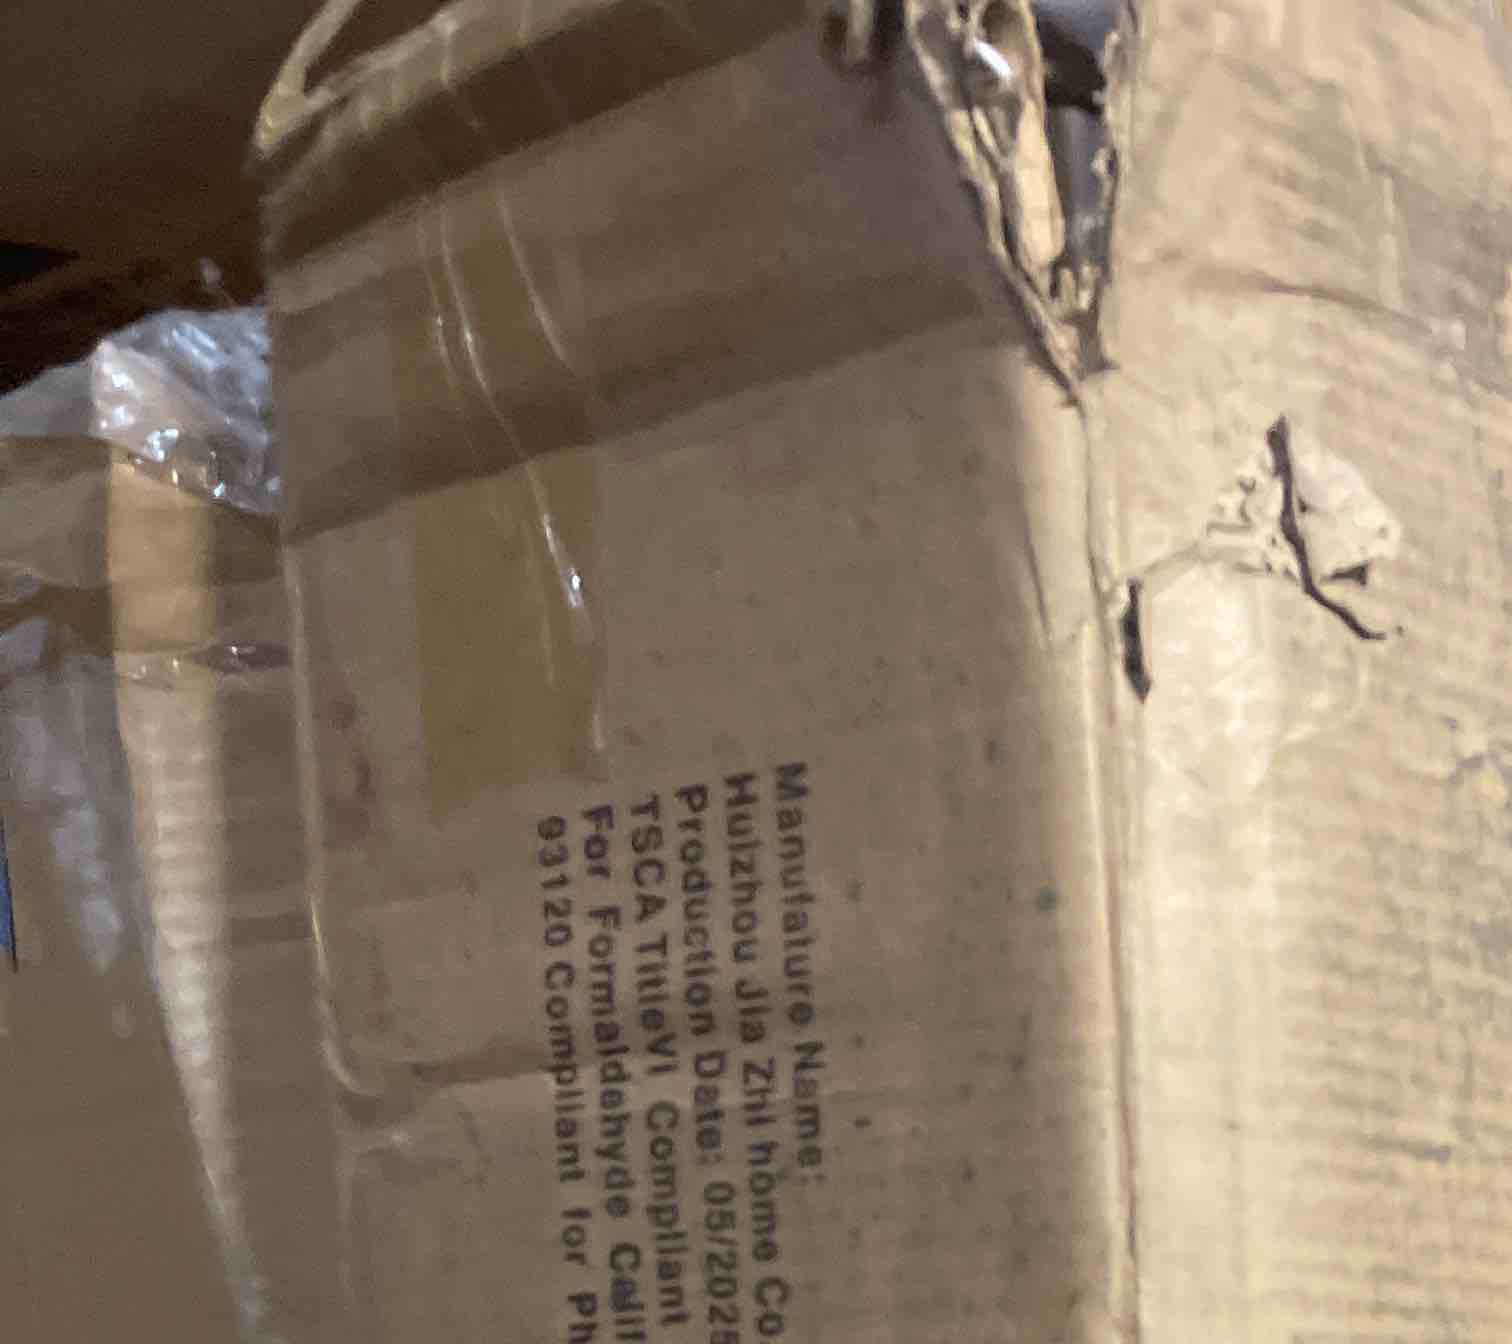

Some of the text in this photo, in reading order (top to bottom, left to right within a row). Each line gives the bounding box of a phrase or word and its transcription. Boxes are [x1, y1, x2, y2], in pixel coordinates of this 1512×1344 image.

[537, 815, 576, 947] 93120
[581, 805, 615, 879] For
[629, 793, 670, 923] TSCA
[723, 774, 772, 964] Huizhou
[675, 784, 718, 1037] Production
[541, 960, 586, 1183] Compliant
[585, 906, 639, 1217] Formaldehyde
[733, 977, 772, 1043] Jia
[690, 1051, 726, 1167] Date:
[742, 1056, 775, 1127] Zhi
[794, 1041, 826, 1186] Name:
[560, 1208, 592, 1266] for
[641, 1102, 690, 1326] Compliant
[746, 1142, 784, 1262] home
